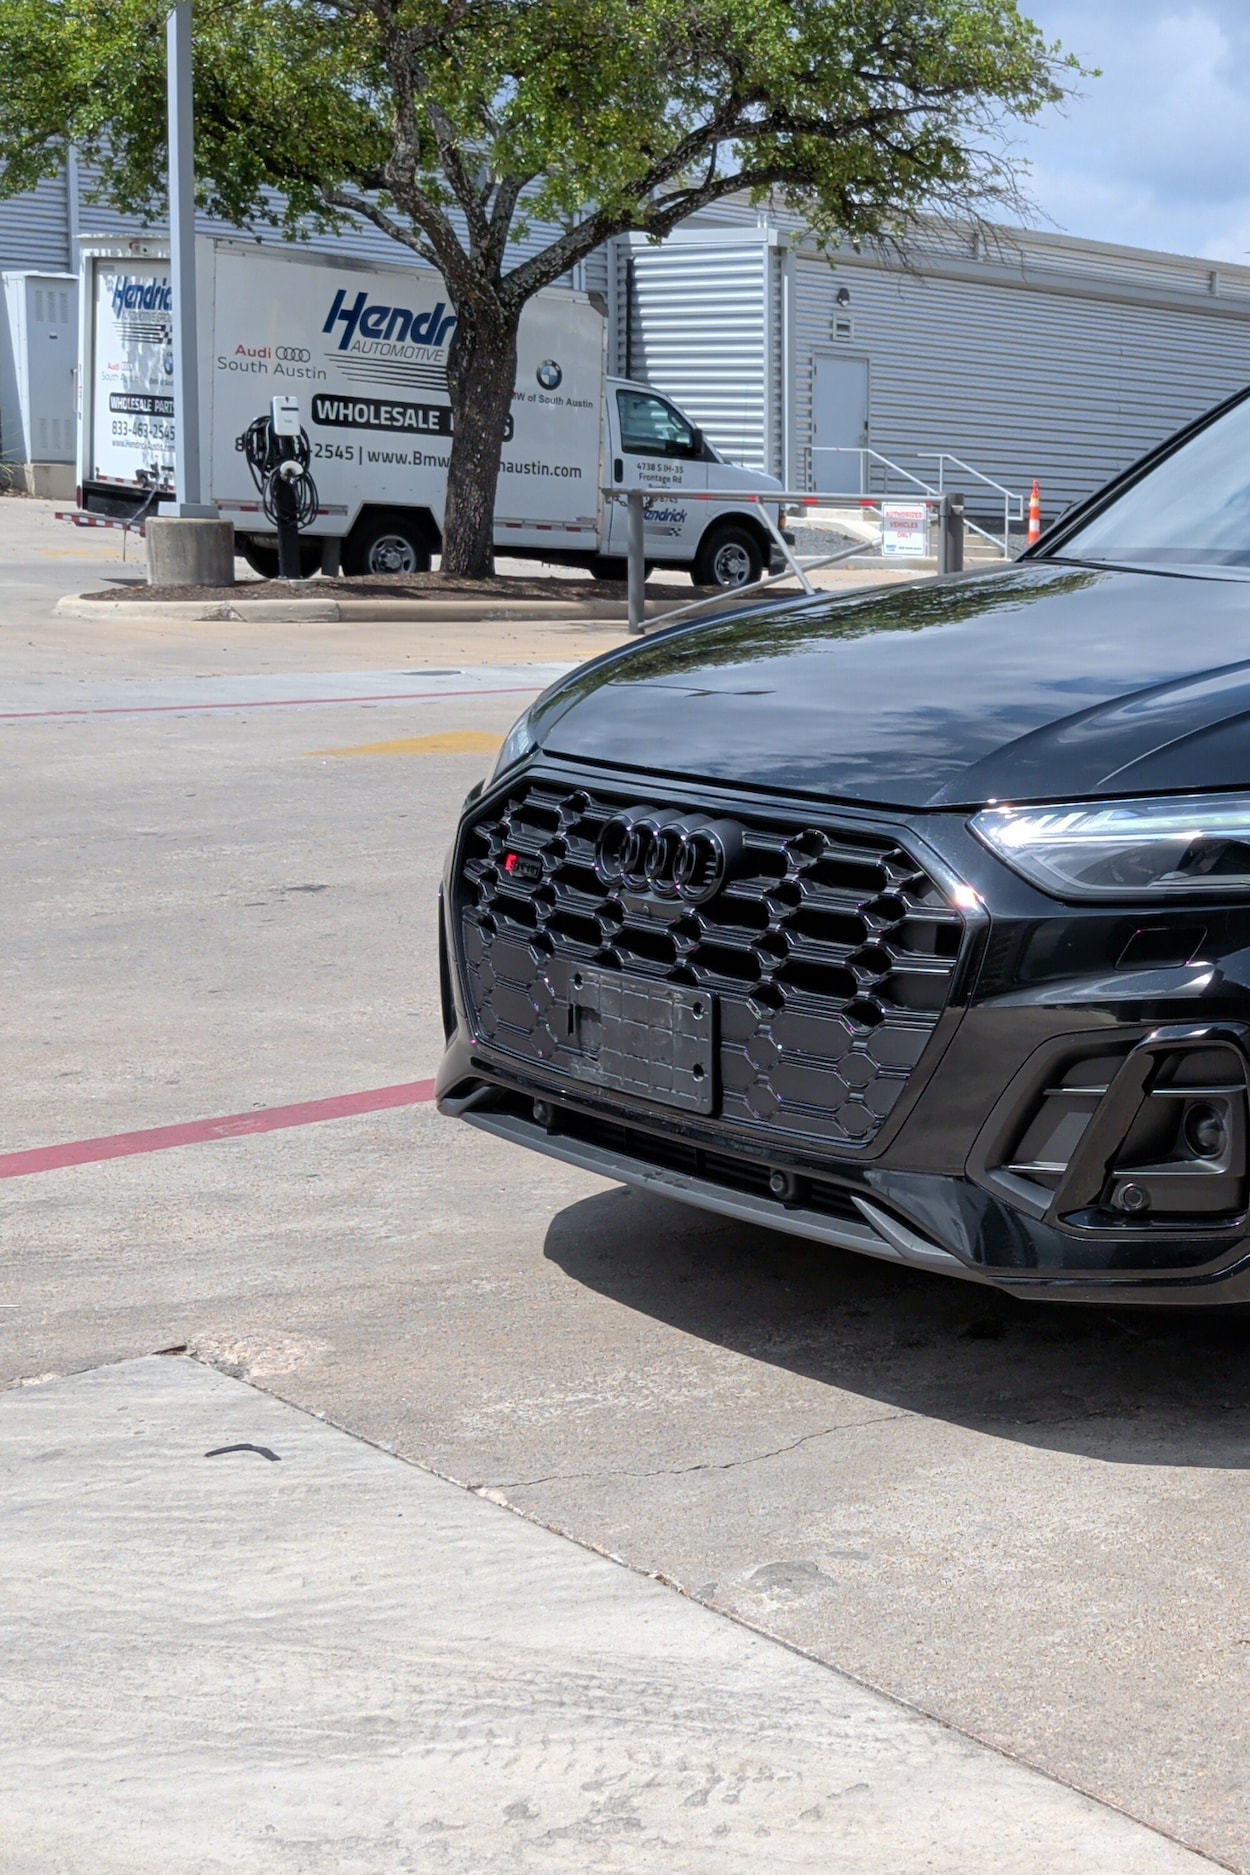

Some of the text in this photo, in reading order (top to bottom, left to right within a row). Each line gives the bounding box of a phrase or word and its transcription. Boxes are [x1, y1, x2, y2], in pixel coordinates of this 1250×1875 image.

[112, 276, 171, 319] Hendric
[322, 289, 457, 351] Hendr
[235, 344, 272, 359] Audi
[351, 340, 445, 363] AUTOMOTIVE
[217, 356, 327, 380] South Austin
[110, 396, 174, 413] WHOLESALE PART
[527, 394, 537, 402] of
[539, 395, 564, 405] South
[566, 398, 594, 408] Austin
[316, 399, 440, 430] WHOLESALE
[639, 473, 671, 484] Frontage
[643, 508, 688, 523] endrick
[890, 521, 919, 529] VEHICLES
